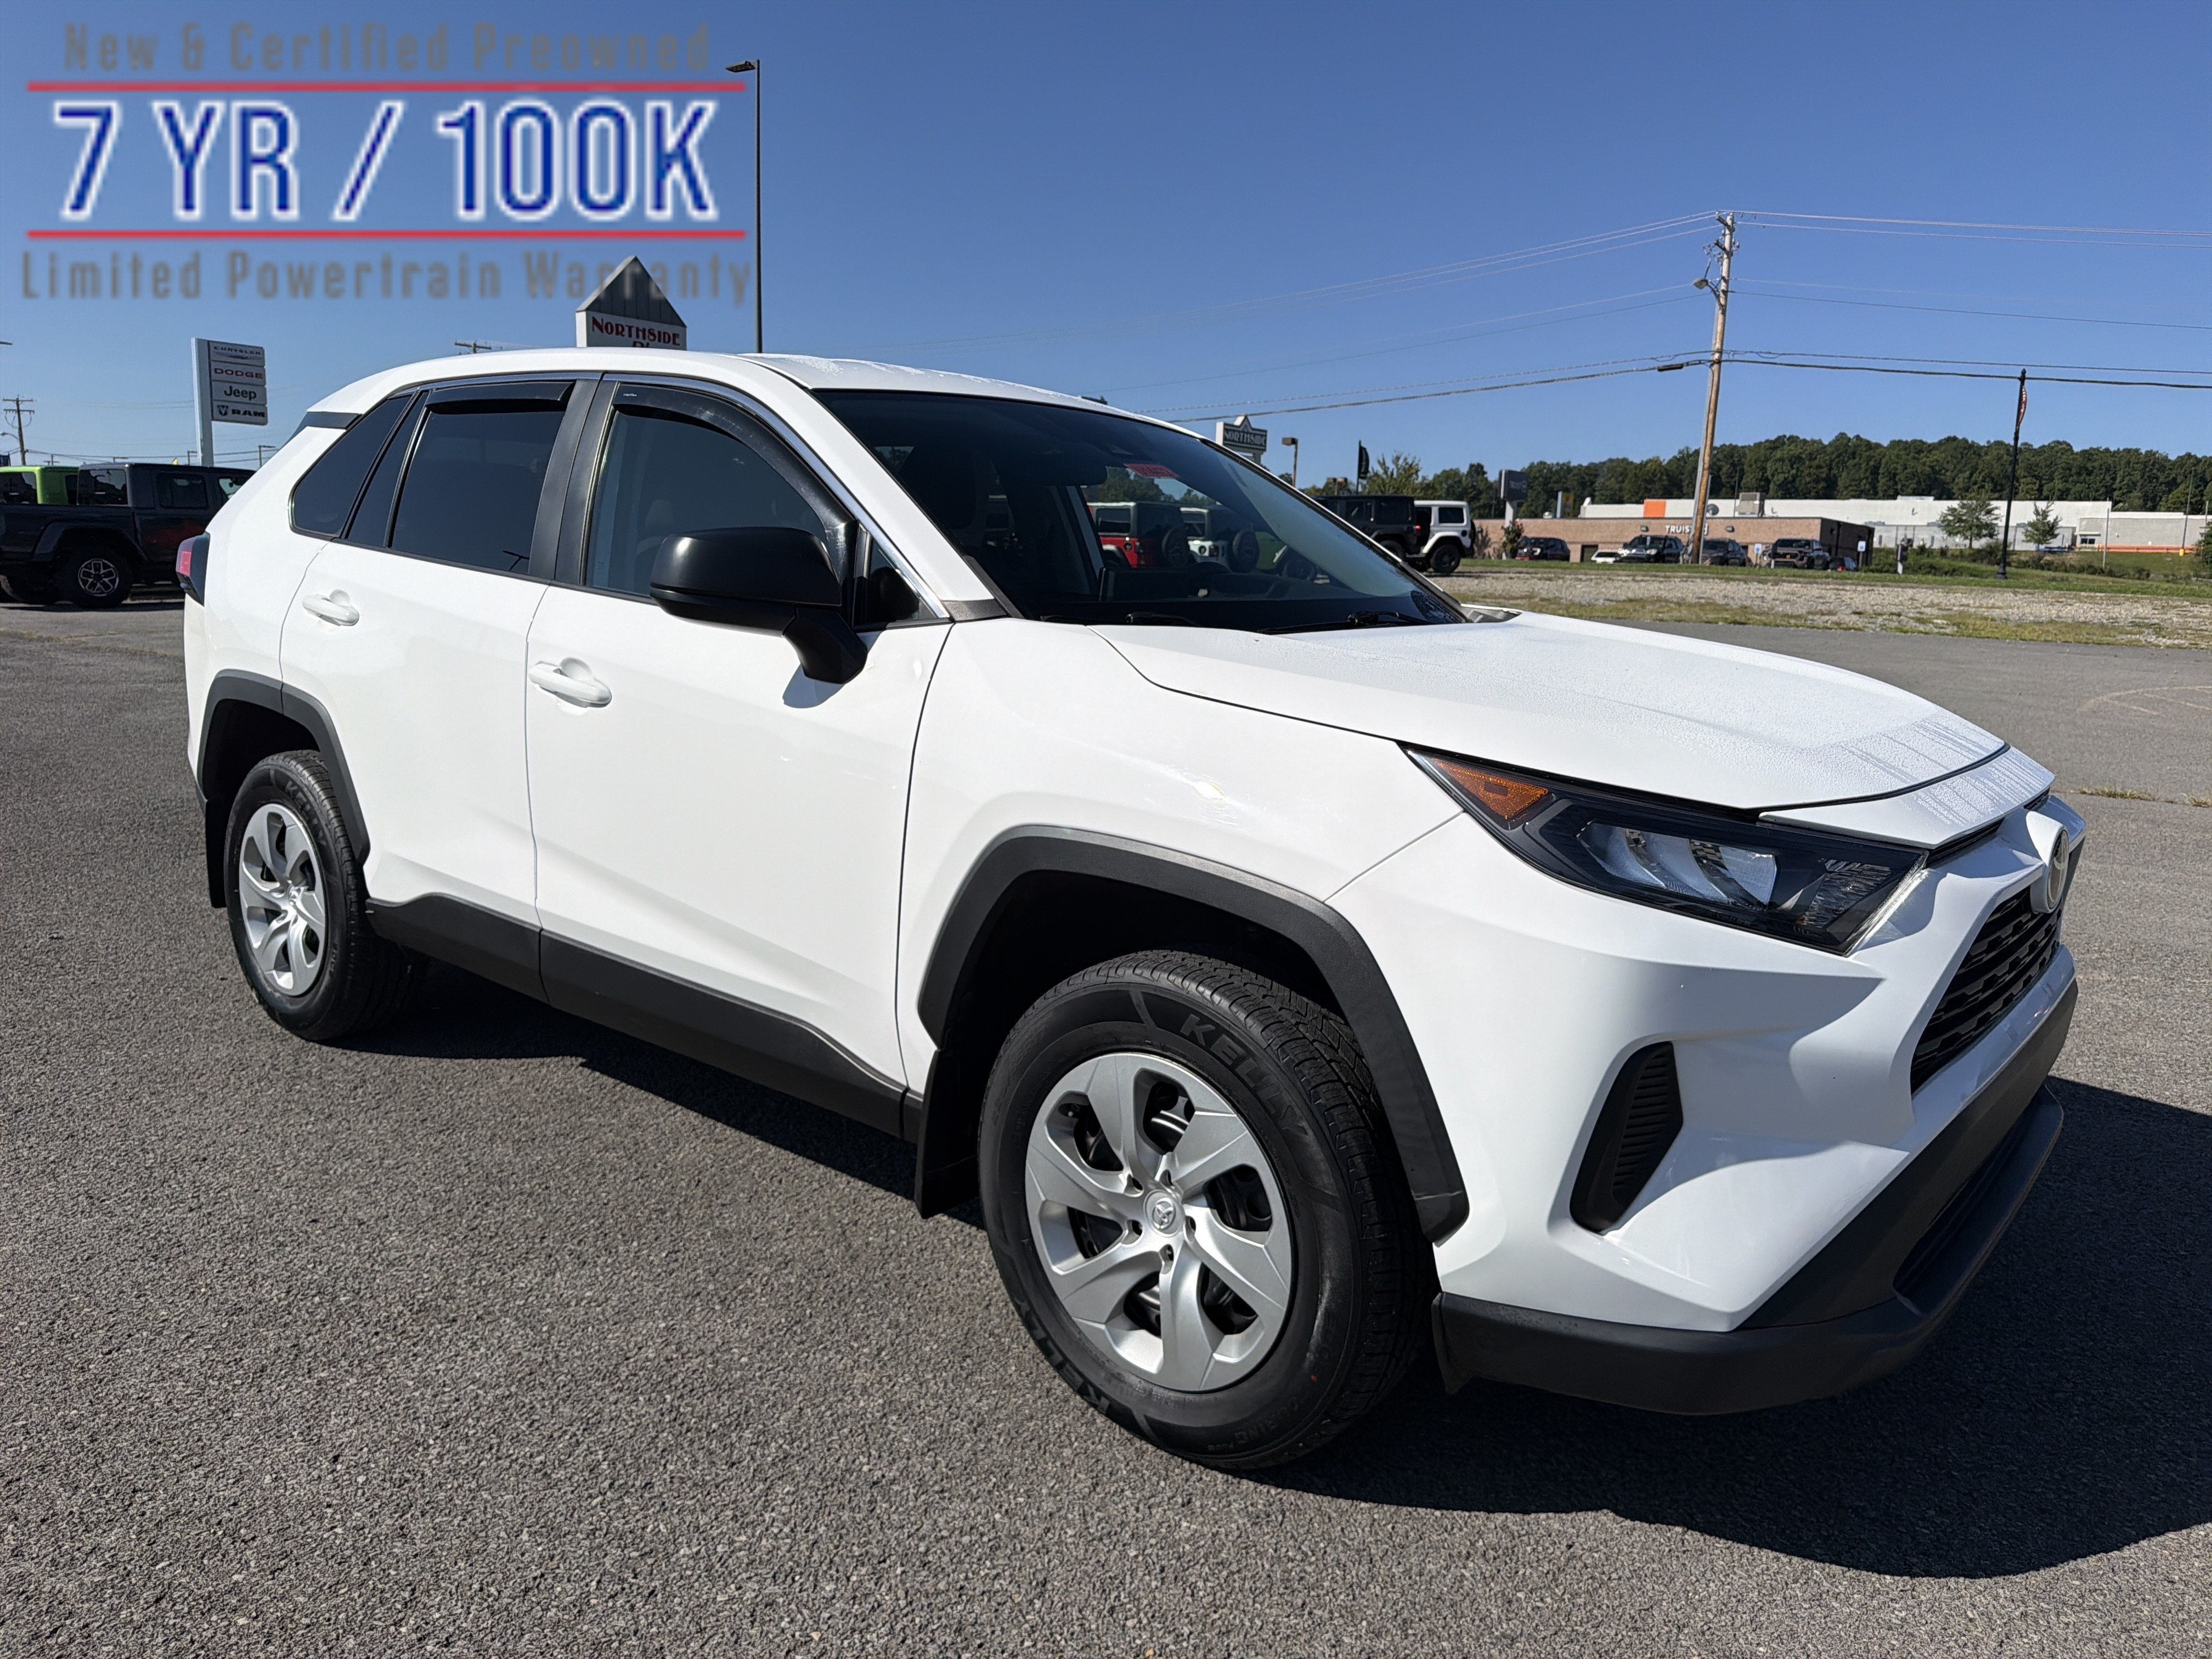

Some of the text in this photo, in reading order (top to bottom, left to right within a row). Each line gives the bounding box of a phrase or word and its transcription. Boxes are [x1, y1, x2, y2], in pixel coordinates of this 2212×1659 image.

[213, 346, 261, 355] CHRYSLER
[214, 368, 263, 379] DODGE
[223, 385, 257, 400] Jeep
[232, 408, 266, 417] RAM
[1665, 524, 1693, 533] TRUIS
[1180, 1013, 1310, 1136] KELLY
